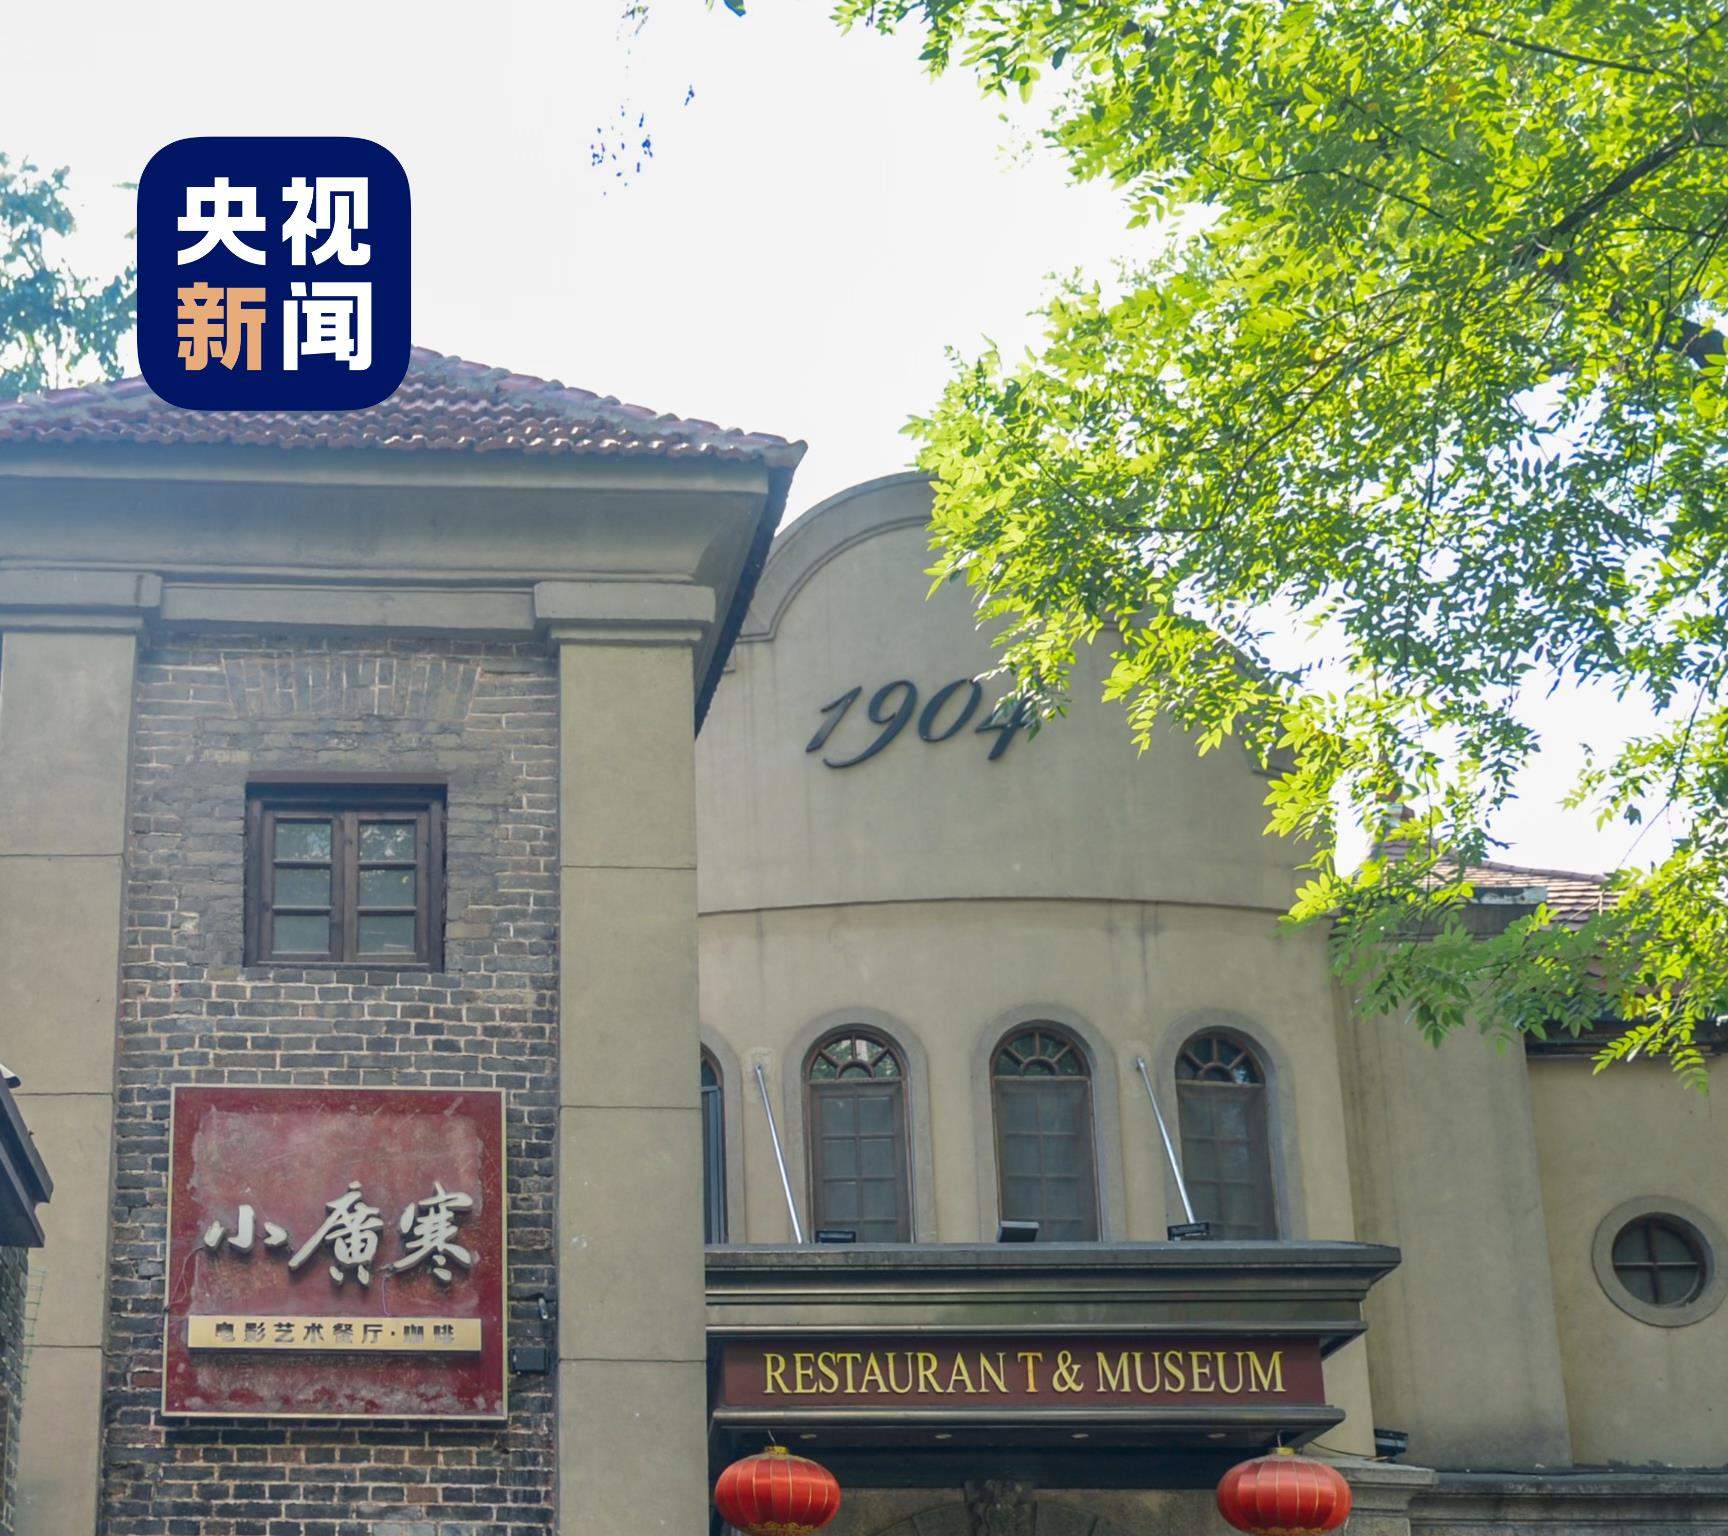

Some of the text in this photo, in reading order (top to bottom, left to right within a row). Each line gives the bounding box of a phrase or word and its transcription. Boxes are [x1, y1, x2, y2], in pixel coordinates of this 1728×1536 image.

[804, 678, 1039, 768] 1904
[204, 1182, 476, 1288] 小廣寒
[1052, 1350, 1084, 1393] &
[1096, 1350, 1287, 1393] MUSEUM
